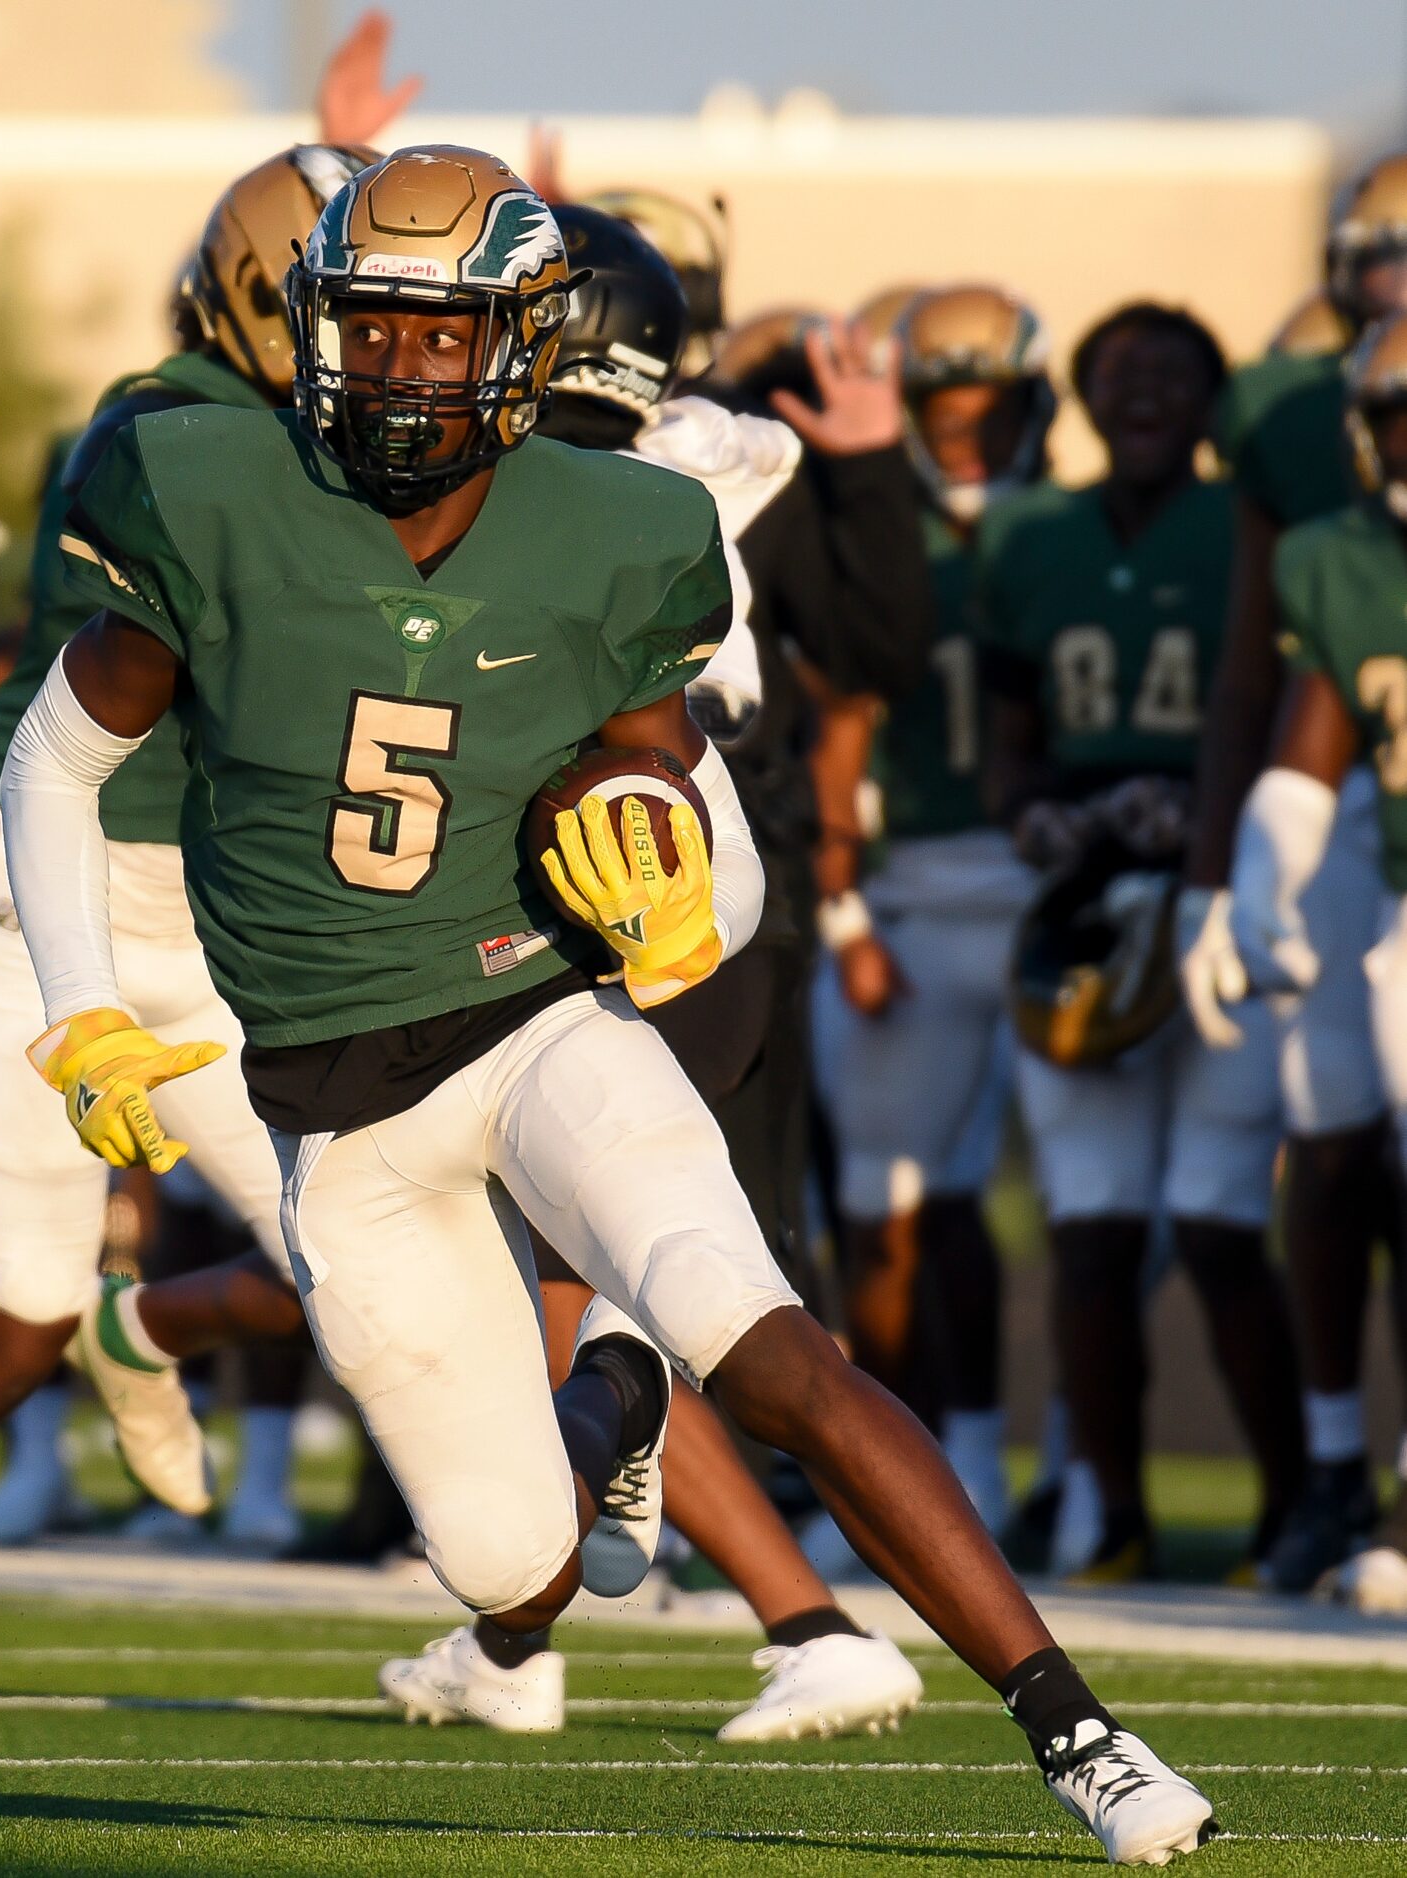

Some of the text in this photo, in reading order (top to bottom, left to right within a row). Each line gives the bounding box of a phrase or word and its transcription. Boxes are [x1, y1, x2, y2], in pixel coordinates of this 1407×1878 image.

[367, 259, 437, 277] Ridell
[1051, 624, 1200, 735] 84
[324, 687, 462, 898] 5
[630, 803, 656, 881] DESOTO
[489, 943, 511, 956] TEAM
